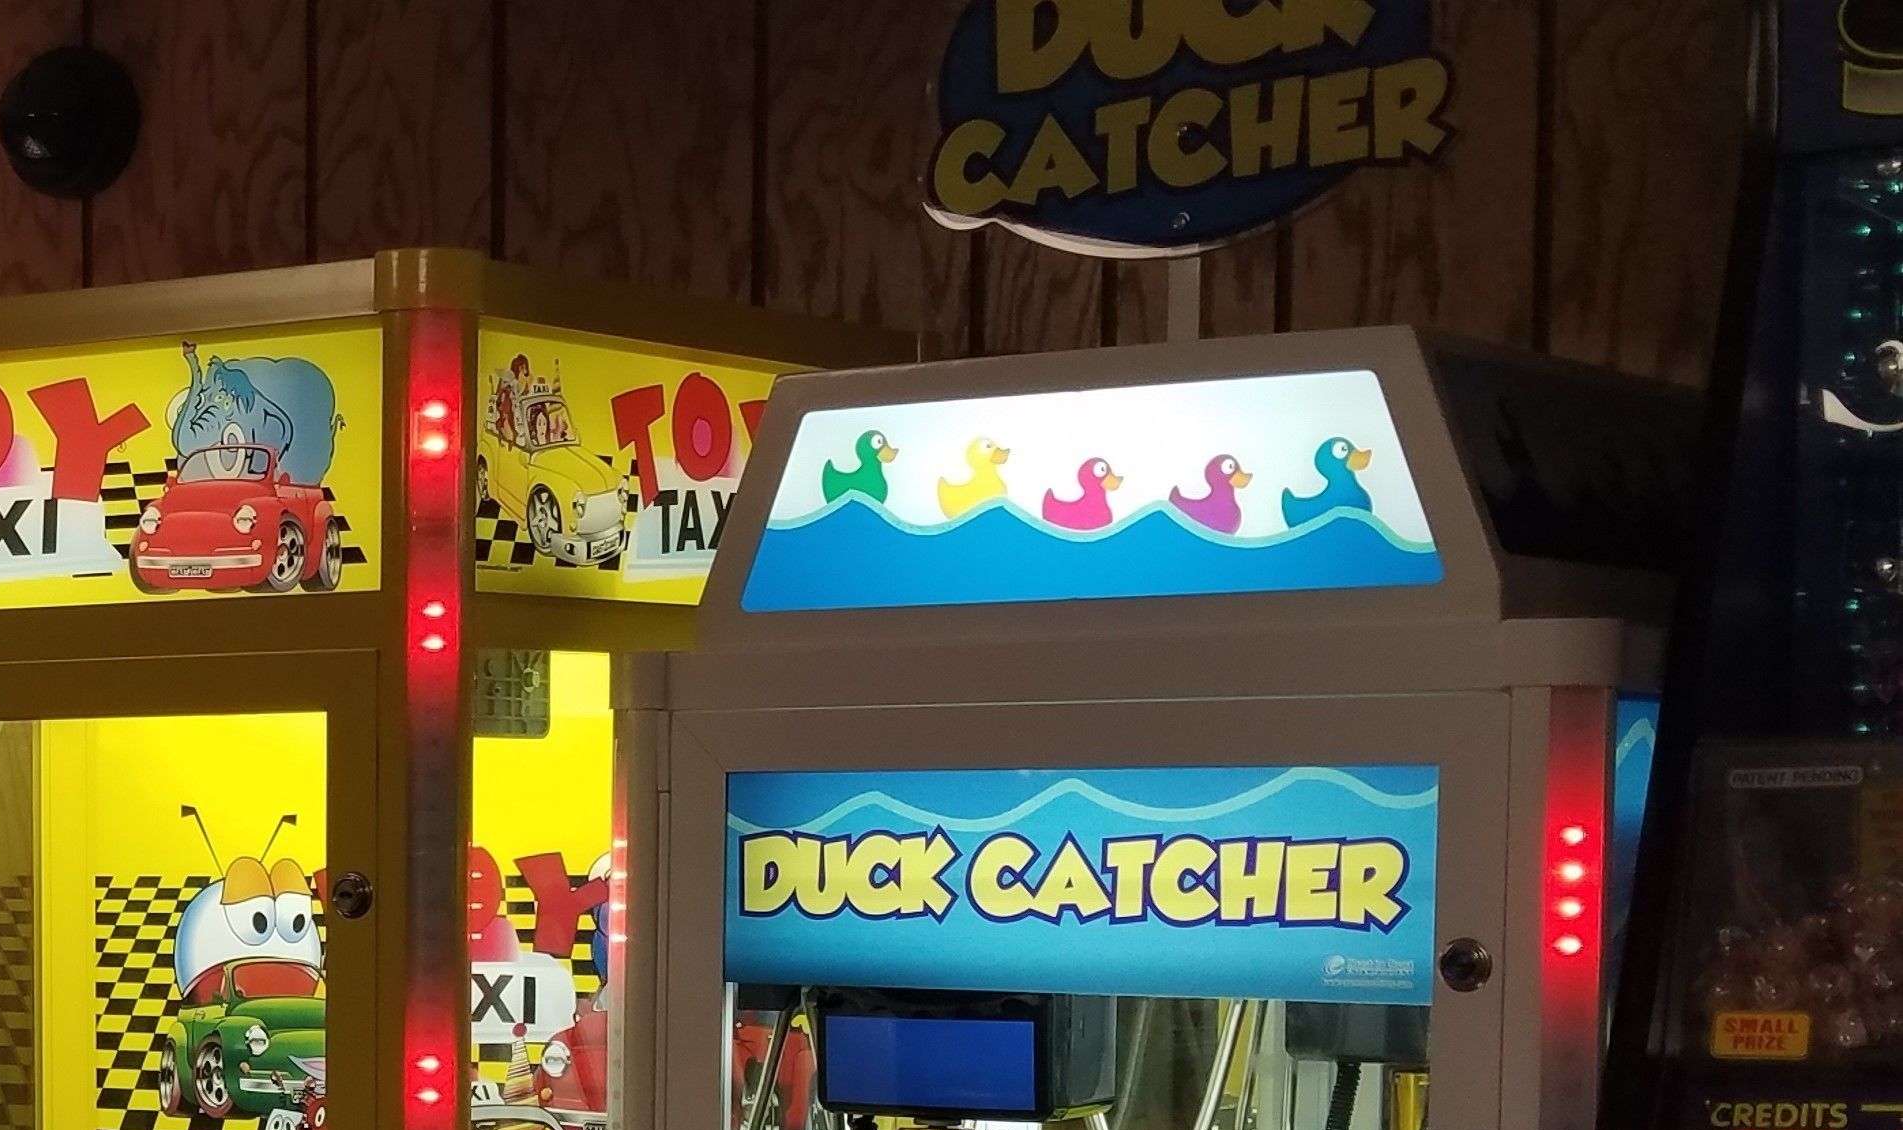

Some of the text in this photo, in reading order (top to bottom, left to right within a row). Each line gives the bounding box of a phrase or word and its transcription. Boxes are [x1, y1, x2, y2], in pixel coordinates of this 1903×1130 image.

[934, 56, 1451, 215] CATCHER
[739, 831, 1411, 928] DUCK CATCHER
[1723, 1017, 1799, 1034] SMALL
[1733, 1035, 1787, 1051] PRIZE
[1710, 1102, 1848, 1129] CREDITS
